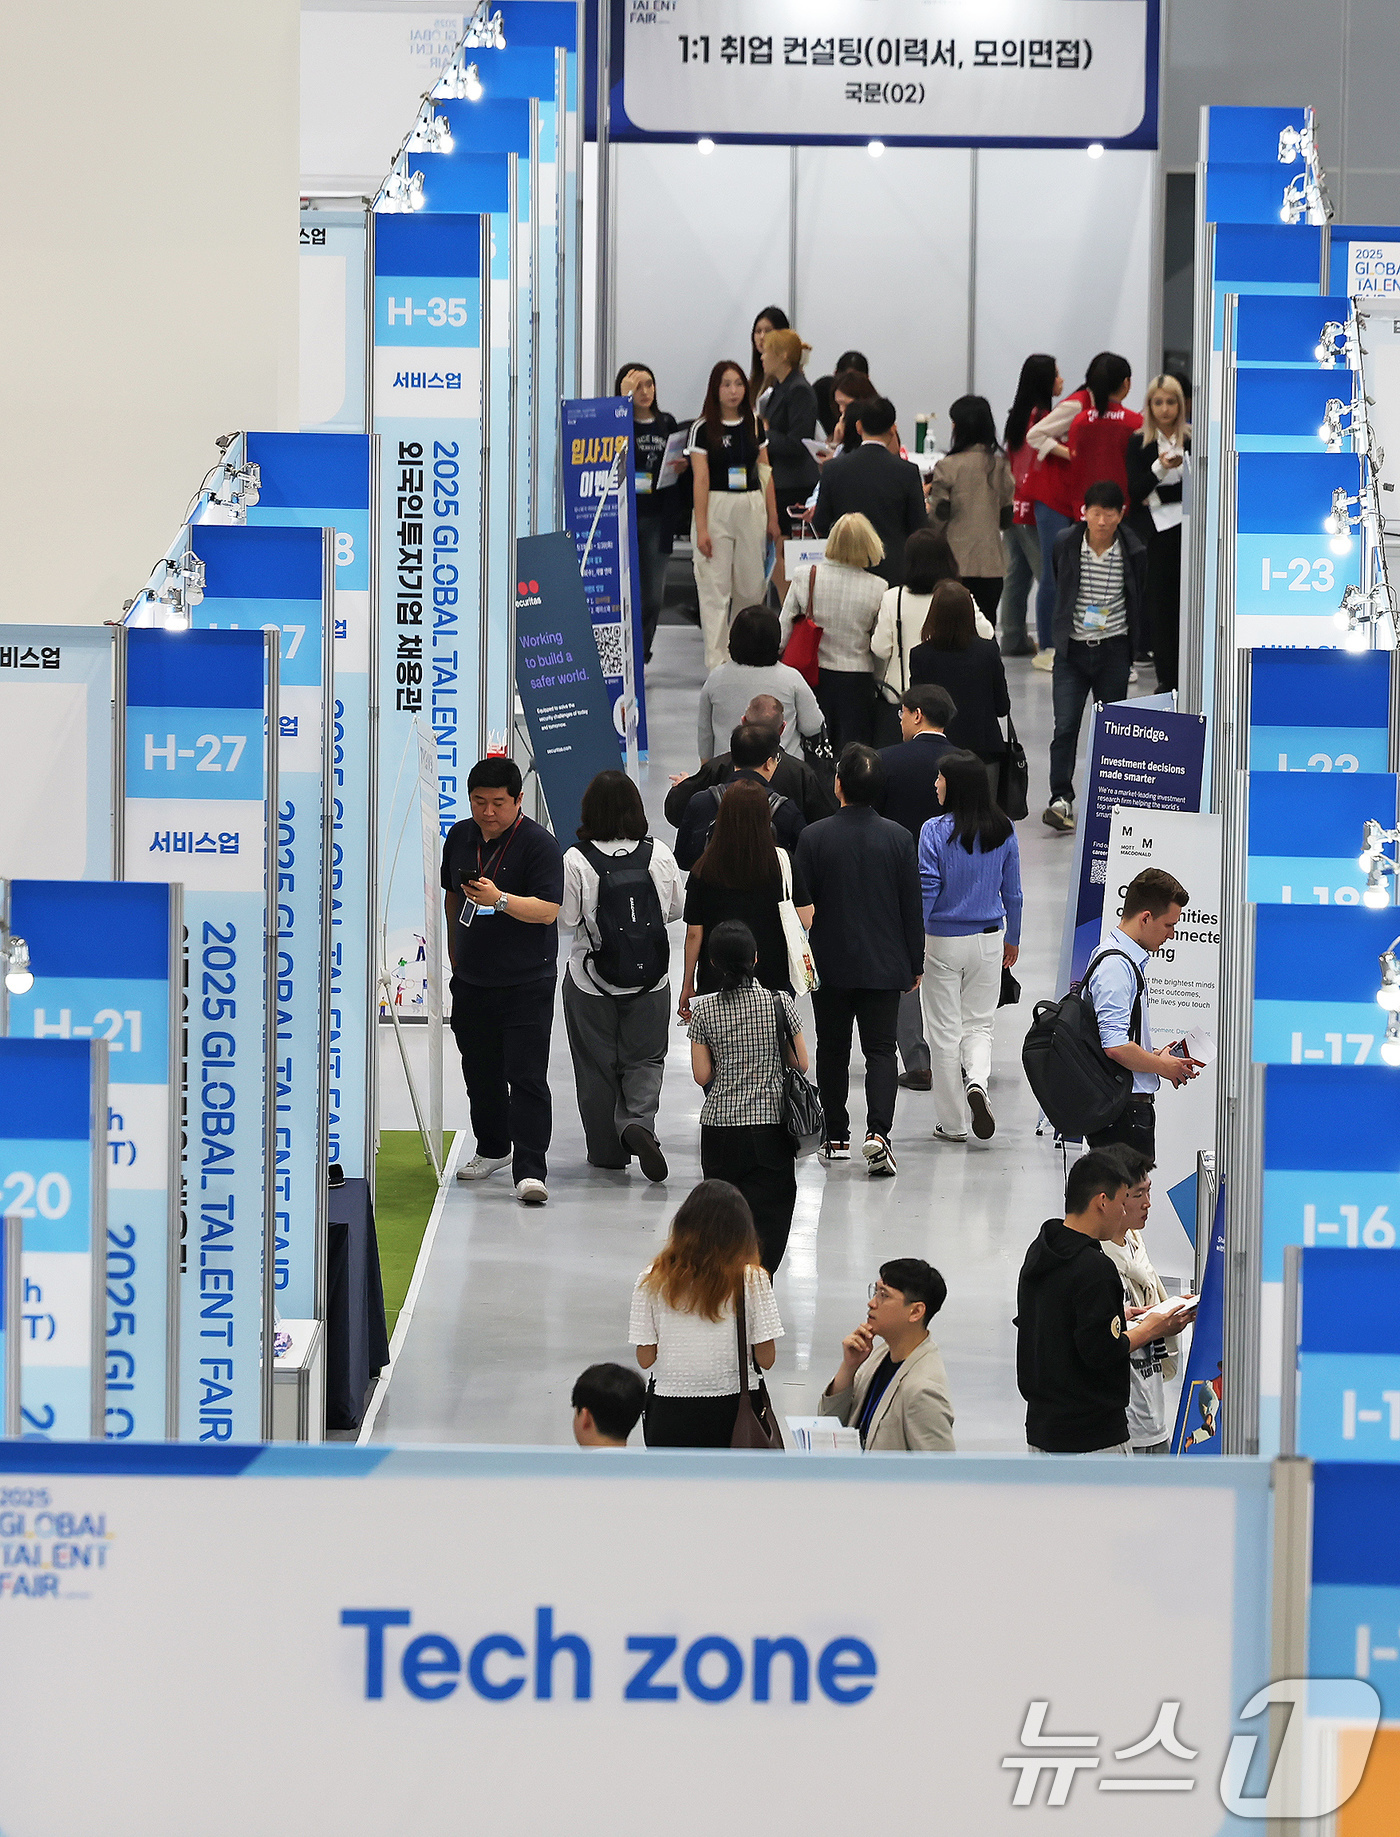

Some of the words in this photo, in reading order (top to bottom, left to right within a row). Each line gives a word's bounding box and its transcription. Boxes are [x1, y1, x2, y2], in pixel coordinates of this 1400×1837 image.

[630, 12, 657, 23] FAIR
[678, 34, 711, 64] 1:1
[720, 35, 773, 65] 취업
[783, 35, 964, 69] 컨설팅(이력서,
[973, 38, 1093, 69] 모의면접)
[845, 81, 925, 105] 국문(02)
[1355, 249, 1383, 259] 2025
[388, 296, 468, 327] H-35
[393, 371, 462, 389] 서비스업
[433, 440, 460, 517] 2025
[397, 441, 424, 625] 외국인투자기업
[432, 525, 459, 646] GLOBAL
[1261, 557, 1336, 592] I-23
[515, 596, 542, 608] ecuritas
[519, 631, 563, 648] Working
[396, 633, 423, 713] 채용관
[525, 656, 536, 669] to
[537, 651, 564, 667] build
[566, 652, 573, 662] a
[530, 674, 555, 689] safer
[557, 668, 590, 684] world.
[431, 650, 458, 767] TALENT
[1105, 721, 1132, 736] Third
[144, 734, 247, 772] H-27
[1101, 755, 1146, 770] Investment
[1147, 761, 1186, 775] decisions
[1099, 769, 1123, 780] made
[1124, 772, 1156, 784] smarter
[149, 831, 239, 854] 서비스업
[201, 920, 237, 1020] 2025
[1164, 978, 1194, 987] brightest
[1195, 981, 1215, 989] minds
[1291, 1032, 1375, 1065] I-17
[200, 1031, 236, 1189] GLOBAL
[1303, 1204, 1396, 1249] I-16
[199, 1194, 234, 1347] TALENT
[198, 1358, 233, 1442] FAIR
[0, 1511, 116, 1540] GLOBAL
[0, 1542, 111, 1570] TALENT
[340, 1606, 593, 1703] Tech
[624, 1634, 878, 1706] zone
